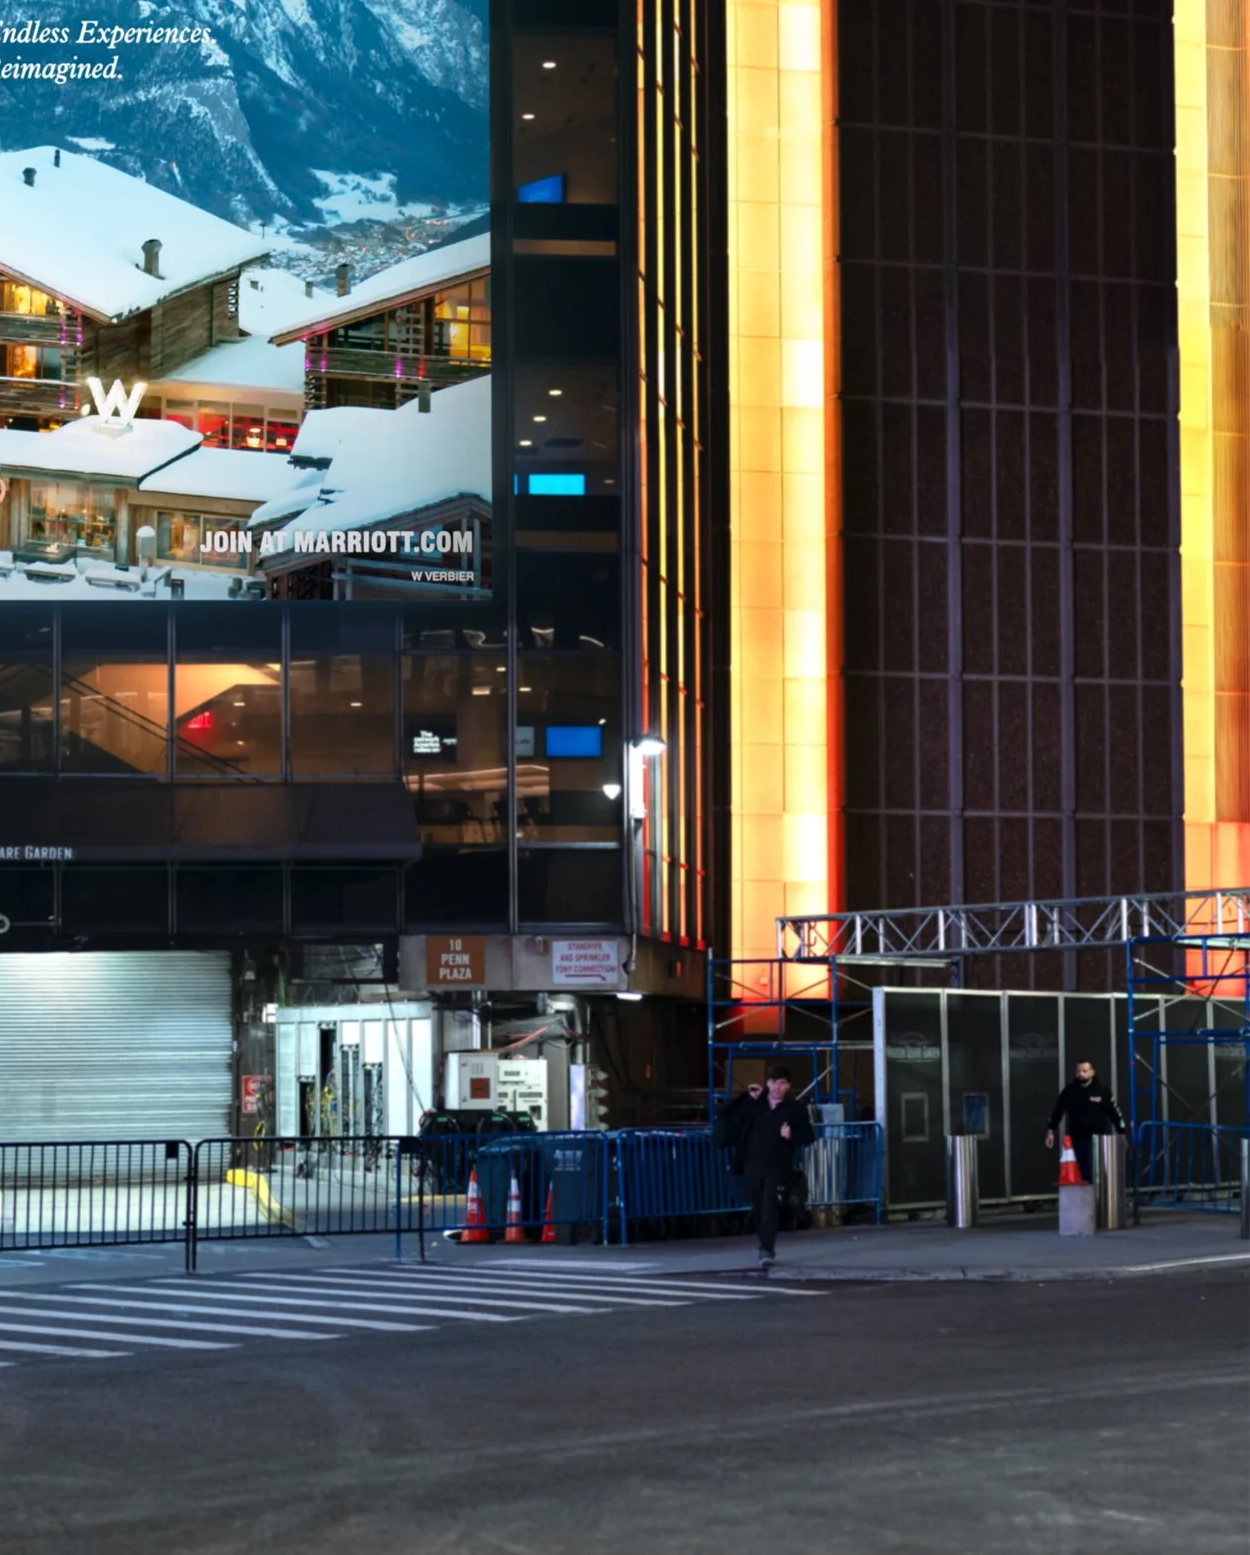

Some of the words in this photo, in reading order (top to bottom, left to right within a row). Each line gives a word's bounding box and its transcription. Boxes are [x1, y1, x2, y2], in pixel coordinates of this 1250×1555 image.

[75, 20, 216, 49] Experiences.
[86, 376, 148, 424] W
[200, 530, 252, 553] JOIN
[259, 530, 287, 553] AT
[294, 530, 473, 553] MARRIOTT.COM
[411, 571, 424, 581] W
[425, 571, 474, 582] VERBIER
[24, 845, 72, 859] GARDEN
[449, 939, 462, 951] 10
[441, 953, 470, 965] PENN
[439, 967, 472, 980] PLAZA
